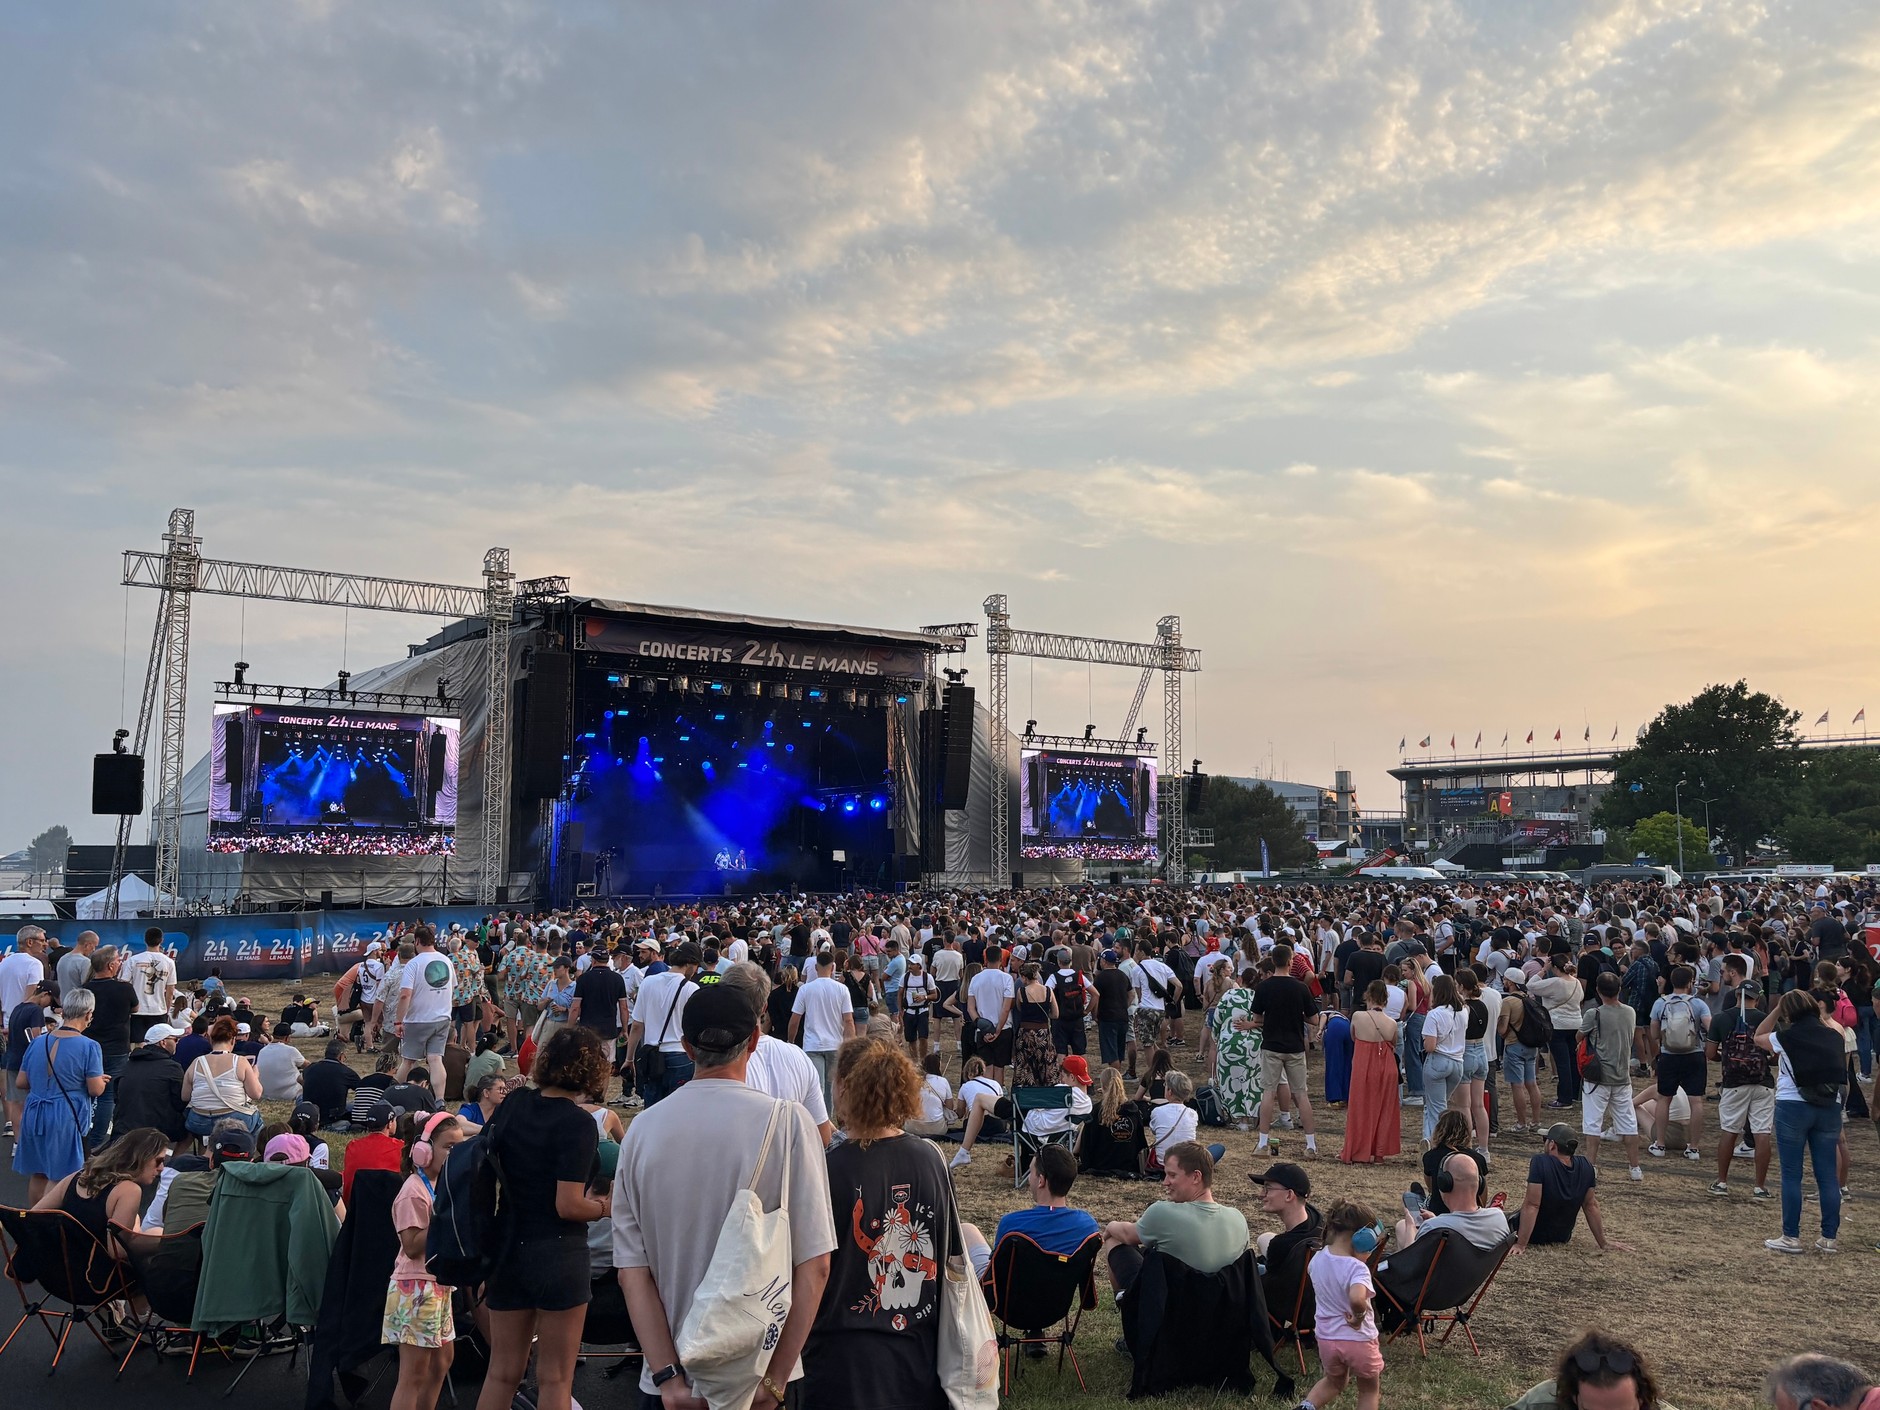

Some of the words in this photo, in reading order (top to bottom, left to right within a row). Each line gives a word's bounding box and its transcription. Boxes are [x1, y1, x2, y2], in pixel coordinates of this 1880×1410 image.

[639, 641, 733, 663] CONCERTS
[788, 653, 816, 670] LE
[278, 716, 324, 726] CONCERTS
[350, 720, 364, 729] LE
[698, 975, 721, 984] 46
[915, 1202, 935, 1219] It's
[915, 1303, 933, 1320] die
